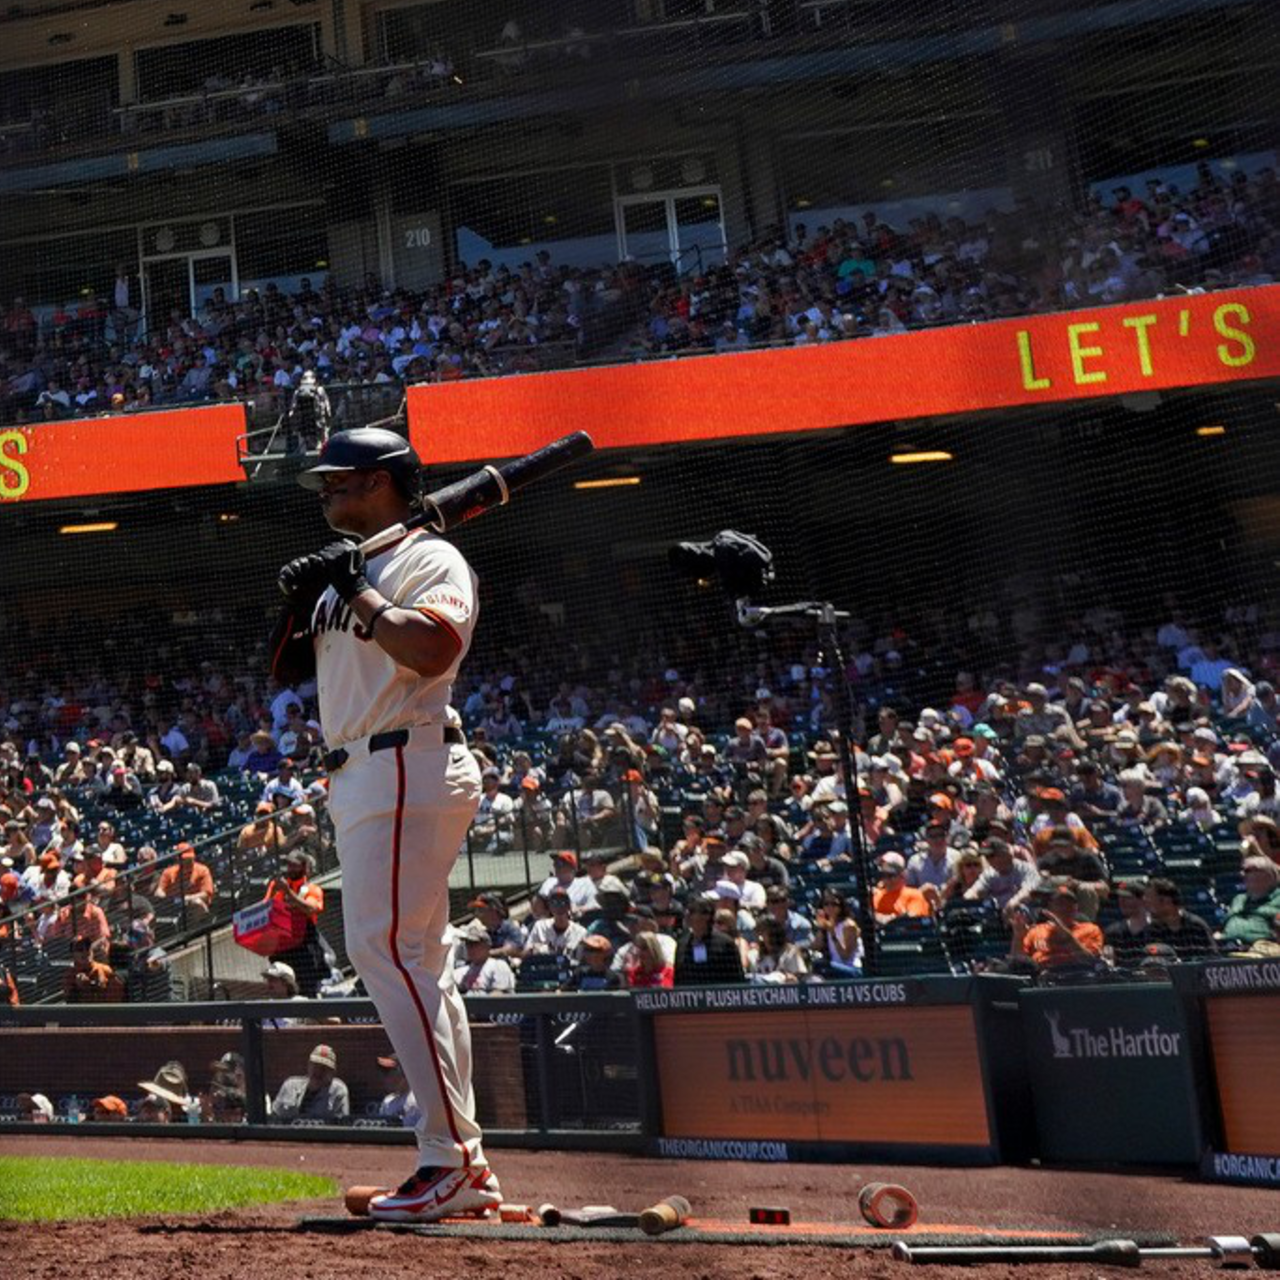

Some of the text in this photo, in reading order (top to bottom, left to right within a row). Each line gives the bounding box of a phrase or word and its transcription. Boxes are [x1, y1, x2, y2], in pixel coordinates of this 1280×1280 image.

[404, 228, 430, 248] 210
[1017, 302, 1256, 391] LET'S
[636, 992, 668, 1009] HELLO
[705, 988, 741, 1007] PLUSH
[742, 987, 799, 1005] KEYCHAIN
[807, 986, 837, 1004] JUNE
[841, 986, 854, 1003] 14
[854, 985, 871, 1002] VS
[871, 983, 907, 1002] CUBS
[1070, 1028, 1109, 1058] The
[726, 1034, 914, 1082] nuveen
[657, 1137, 789, 1160] THEORGANICCOUP.COM
